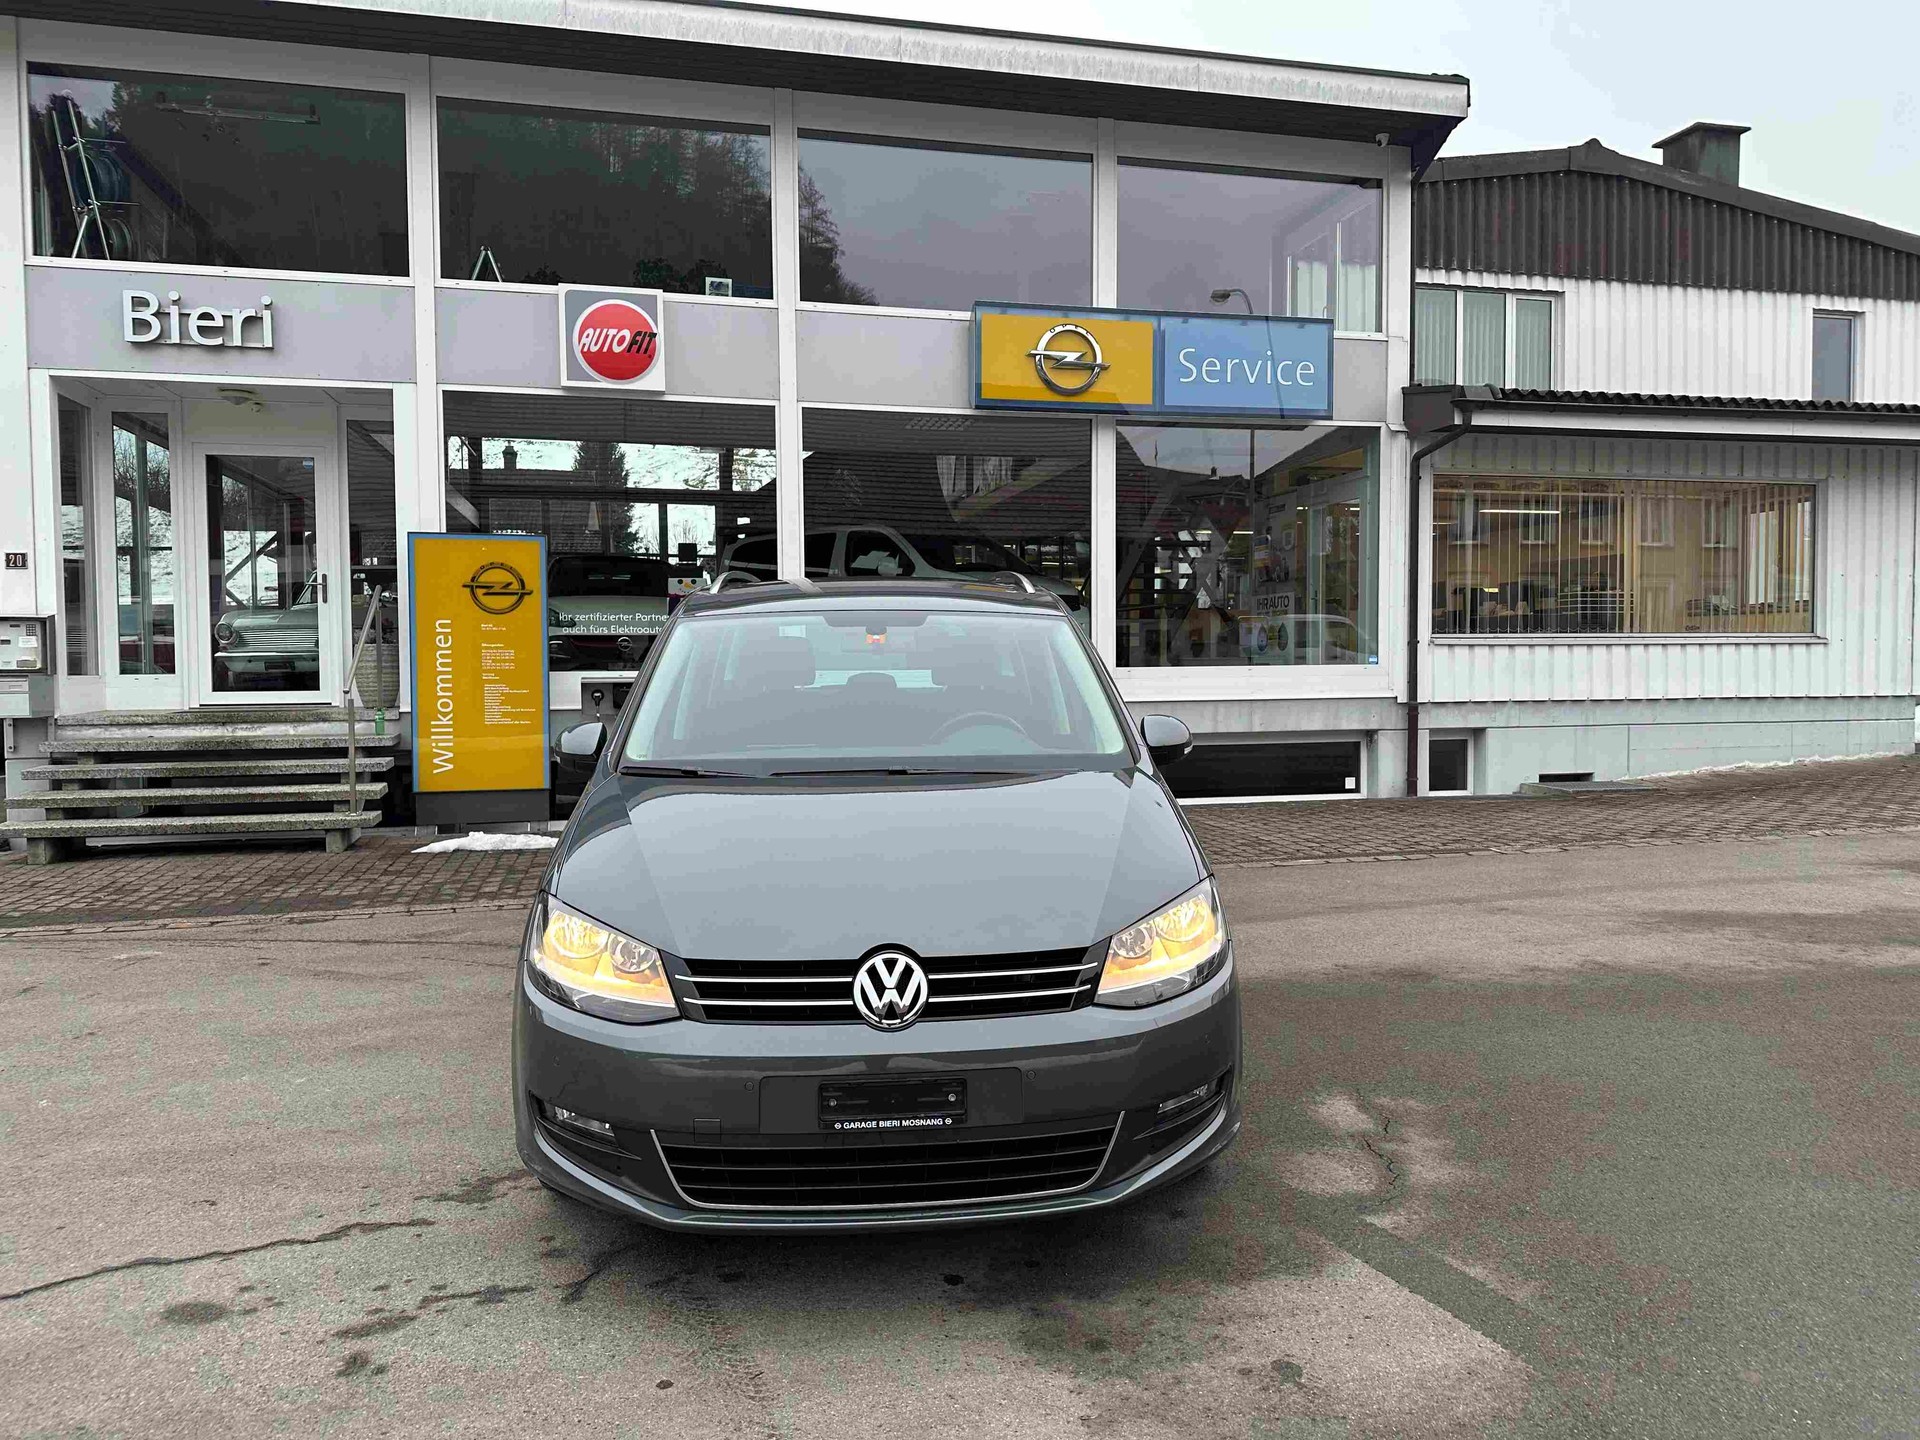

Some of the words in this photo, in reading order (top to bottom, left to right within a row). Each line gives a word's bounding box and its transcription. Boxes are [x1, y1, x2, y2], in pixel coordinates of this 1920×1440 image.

[122, 290, 273, 348] Bieri
[1049, 324, 1090, 336] OPEL
[1178, 348, 1315, 386] Service
[9, 554, 22, 567] 20
[559, 612, 571, 621] Ihr
[575, 612, 633, 622] zertifizierter
[562, 624, 587, 633] auch
[590, 624, 608, 633] fürs
[431, 619, 454, 774] Willkommen
[843, 1121, 877, 1129] GARAGE
[879, 1120, 900, 1128] BIERI
[902, 1118, 943, 1127] MOSNANG
